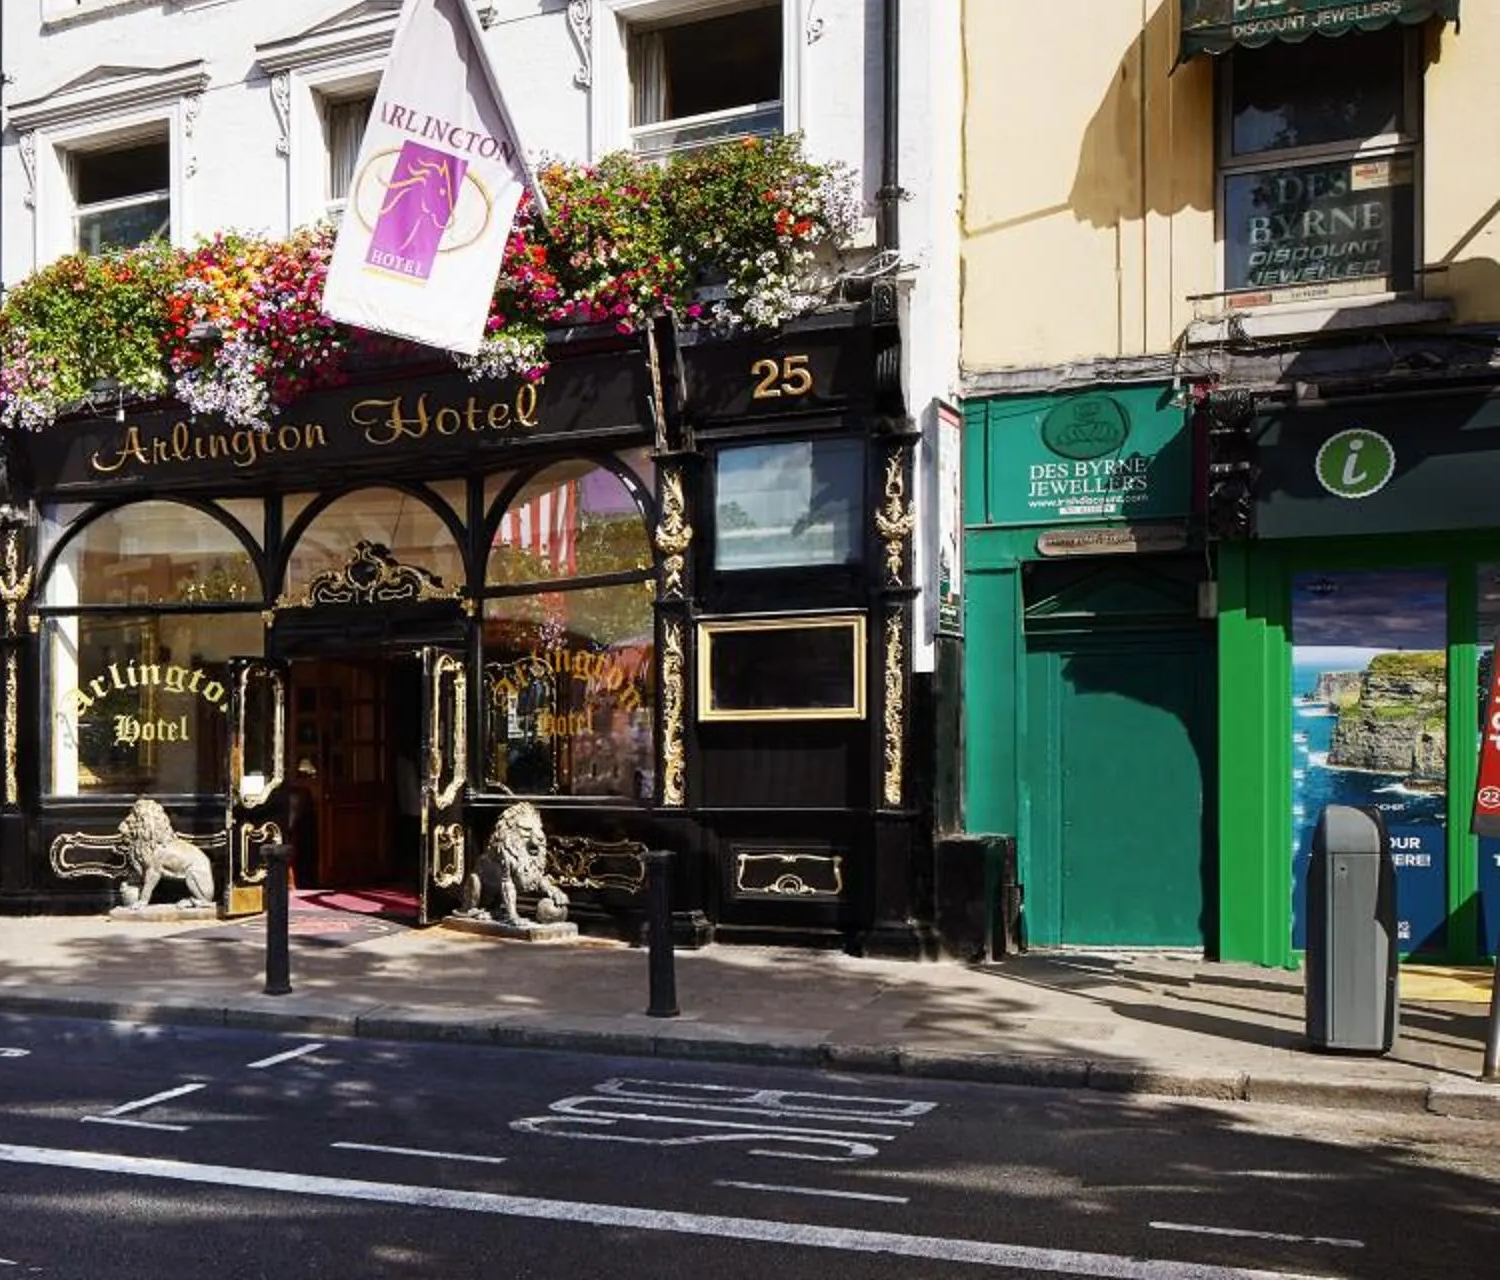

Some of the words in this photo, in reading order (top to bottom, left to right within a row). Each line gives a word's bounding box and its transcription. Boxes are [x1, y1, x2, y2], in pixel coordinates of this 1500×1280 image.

[1233, 15, 1306, 38] DISCOUNT
[1311, 0, 1401, 27] JEWELLERS
[1277, 170, 1348, 204] DES
[1251, 201, 1385, 244] BYRNE
[371, 248, 425, 277] HOTEL
[1249, 240, 1380, 266] DISCOUNT
[751, 355, 813, 399] 25
[91, 422, 327, 471] Arlington
[351, 383, 539, 445] Hotel
[1029, 463, 1069, 480] DES
[1074, 457, 1148, 477] BYRNE
[1028, 475, 1148, 497] JEWELLERS
[64, 659, 229, 718] Arlingto
[112, 714, 190, 748] Hotel
[536, 704, 594, 738] Hotel
[1389, 837, 1421, 849] UR
[1392, 853, 1431, 866] ERE!
[509, 1077, 940, 1162] BUS
